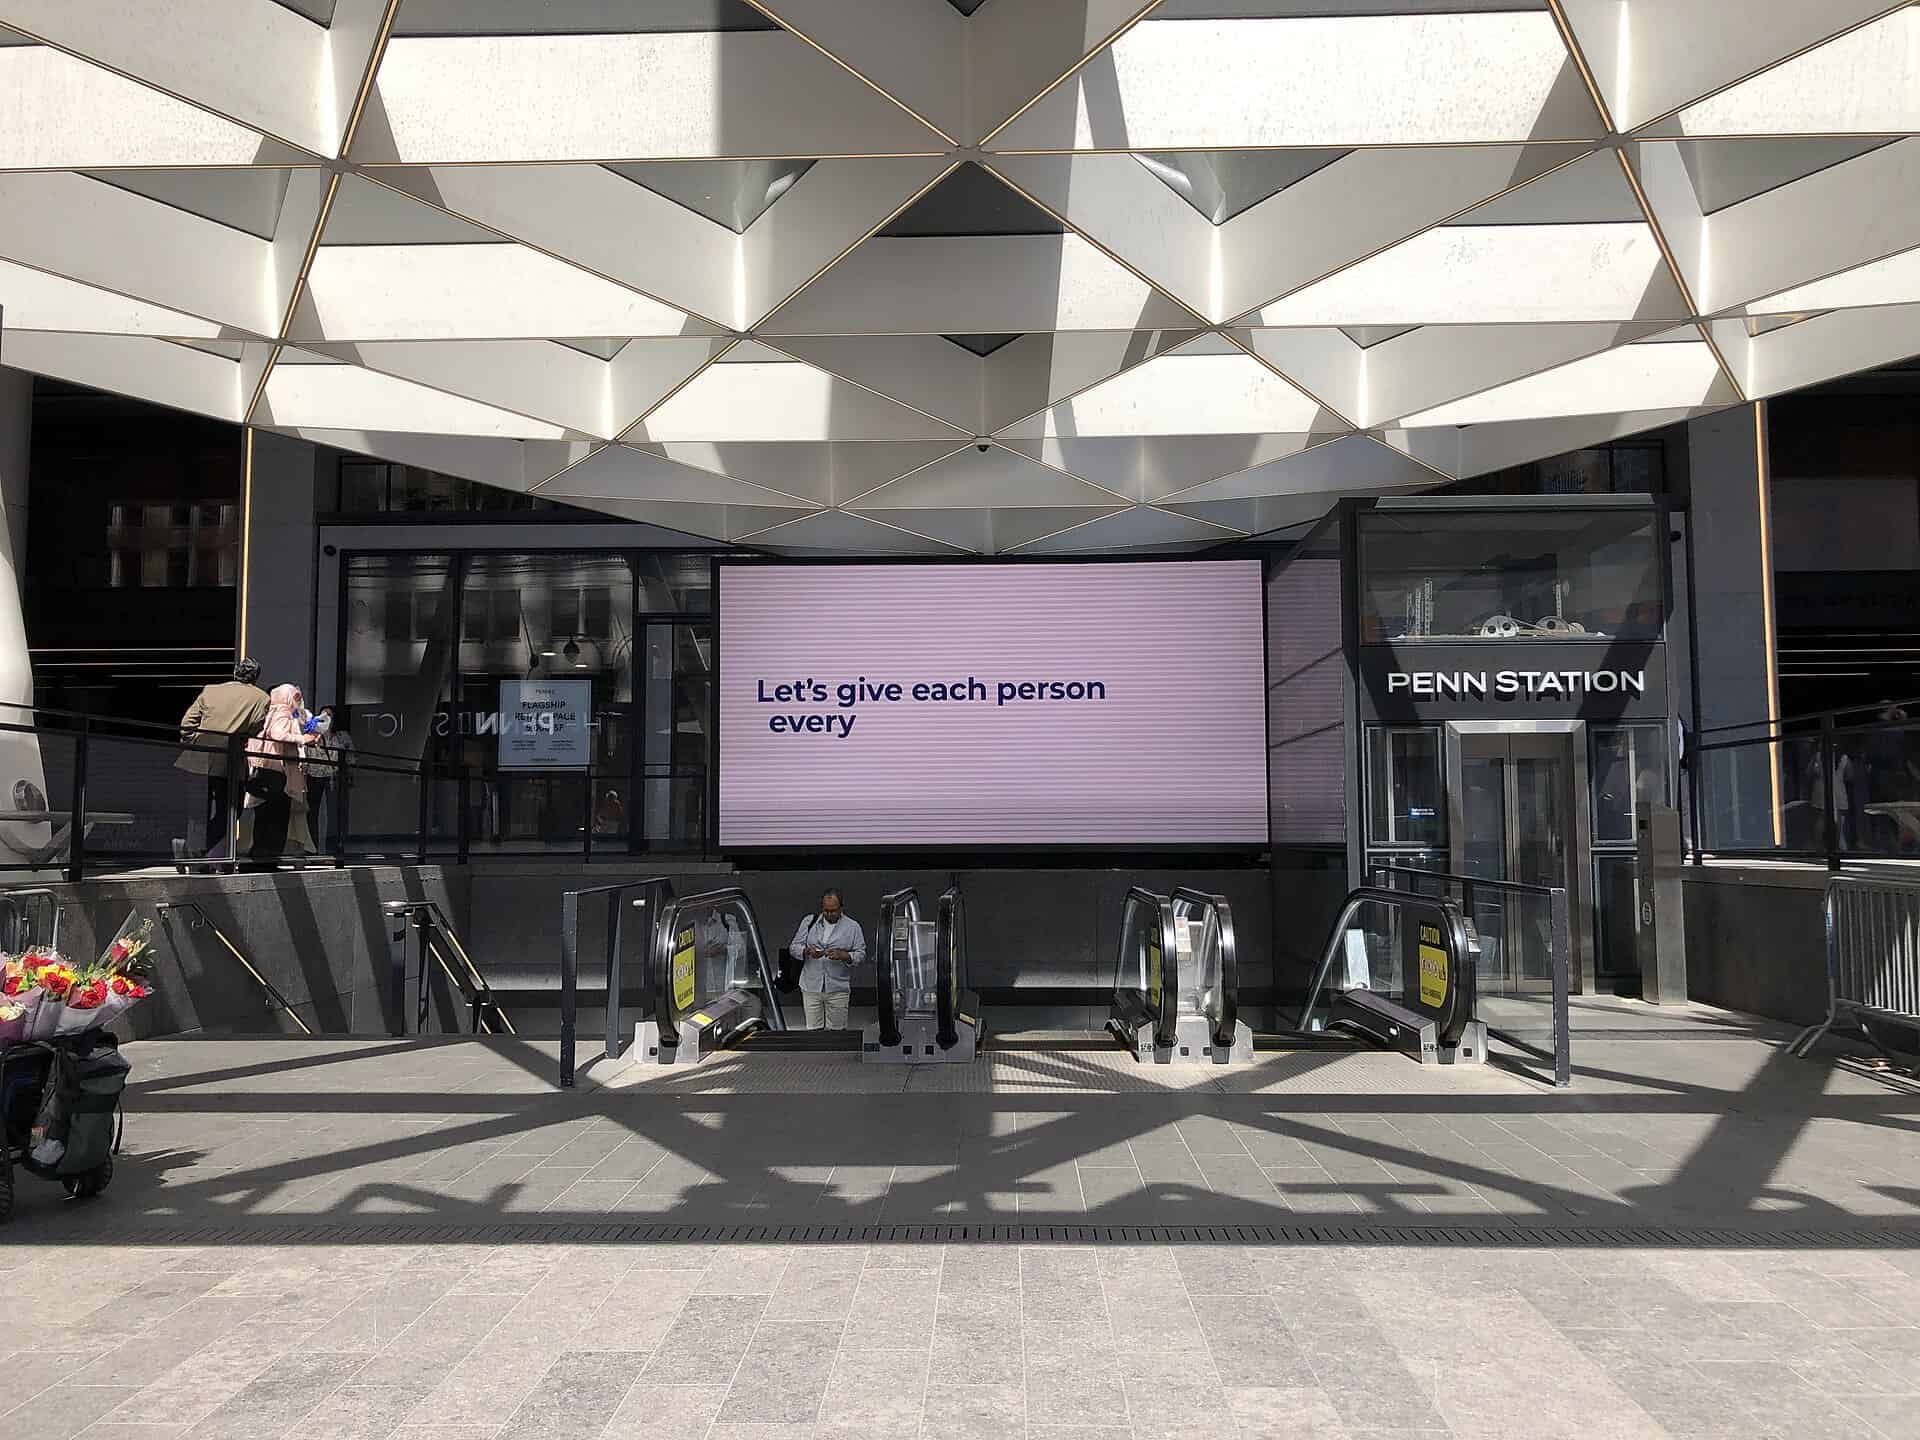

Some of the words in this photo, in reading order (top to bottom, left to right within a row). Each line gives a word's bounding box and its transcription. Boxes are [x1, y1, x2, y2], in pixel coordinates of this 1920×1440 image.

[757, 679, 828, 703] Let’s
[836, 676, 903, 708] give
[911, 677, 987, 702] each
[997, 679, 1106, 706] person
[1387, 671, 1487, 694] PENN
[1495, 670, 1645, 693] STATION
[521, 700, 566, 710] FLAGSHIP
[768, 713, 857, 738] every
